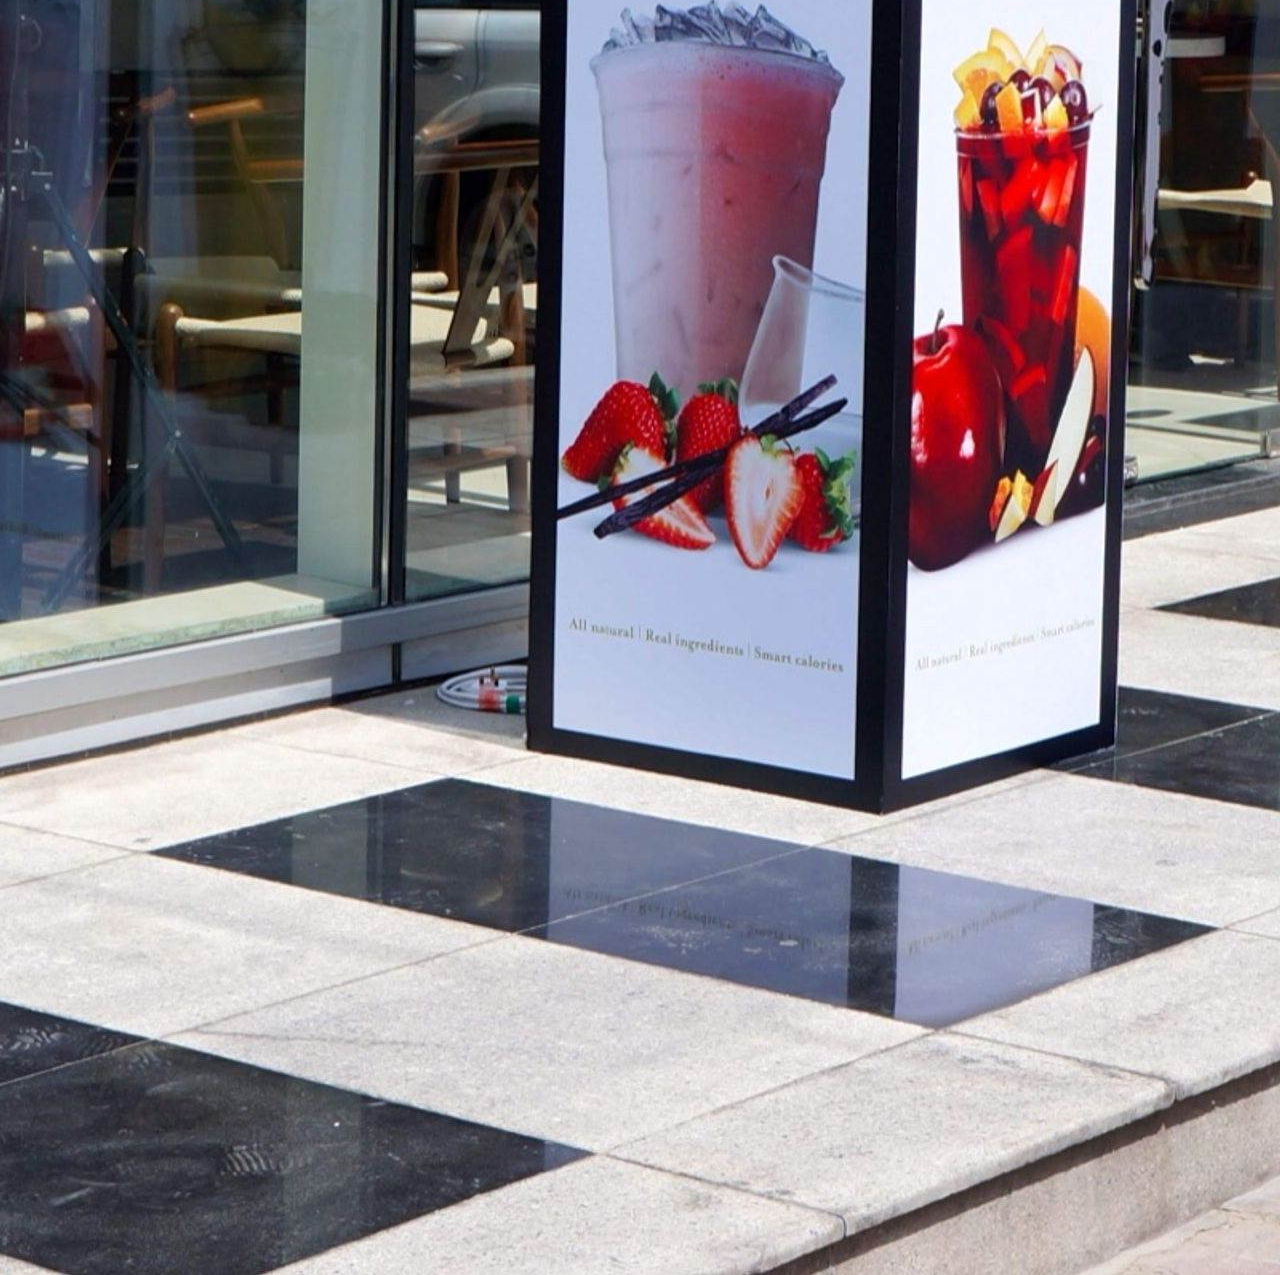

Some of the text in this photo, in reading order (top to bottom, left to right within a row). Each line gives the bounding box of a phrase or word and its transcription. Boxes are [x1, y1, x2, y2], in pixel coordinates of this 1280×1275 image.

[569, 617, 845, 673] All natural Real ingredients Smart calories
[916, 657, 929, 672] All
[931, 648, 962, 666] natural
[969, 644, 988, 658] Real
[990, 633, 1035, 654] ingredients
[1040, 624, 1064, 639] Smart
